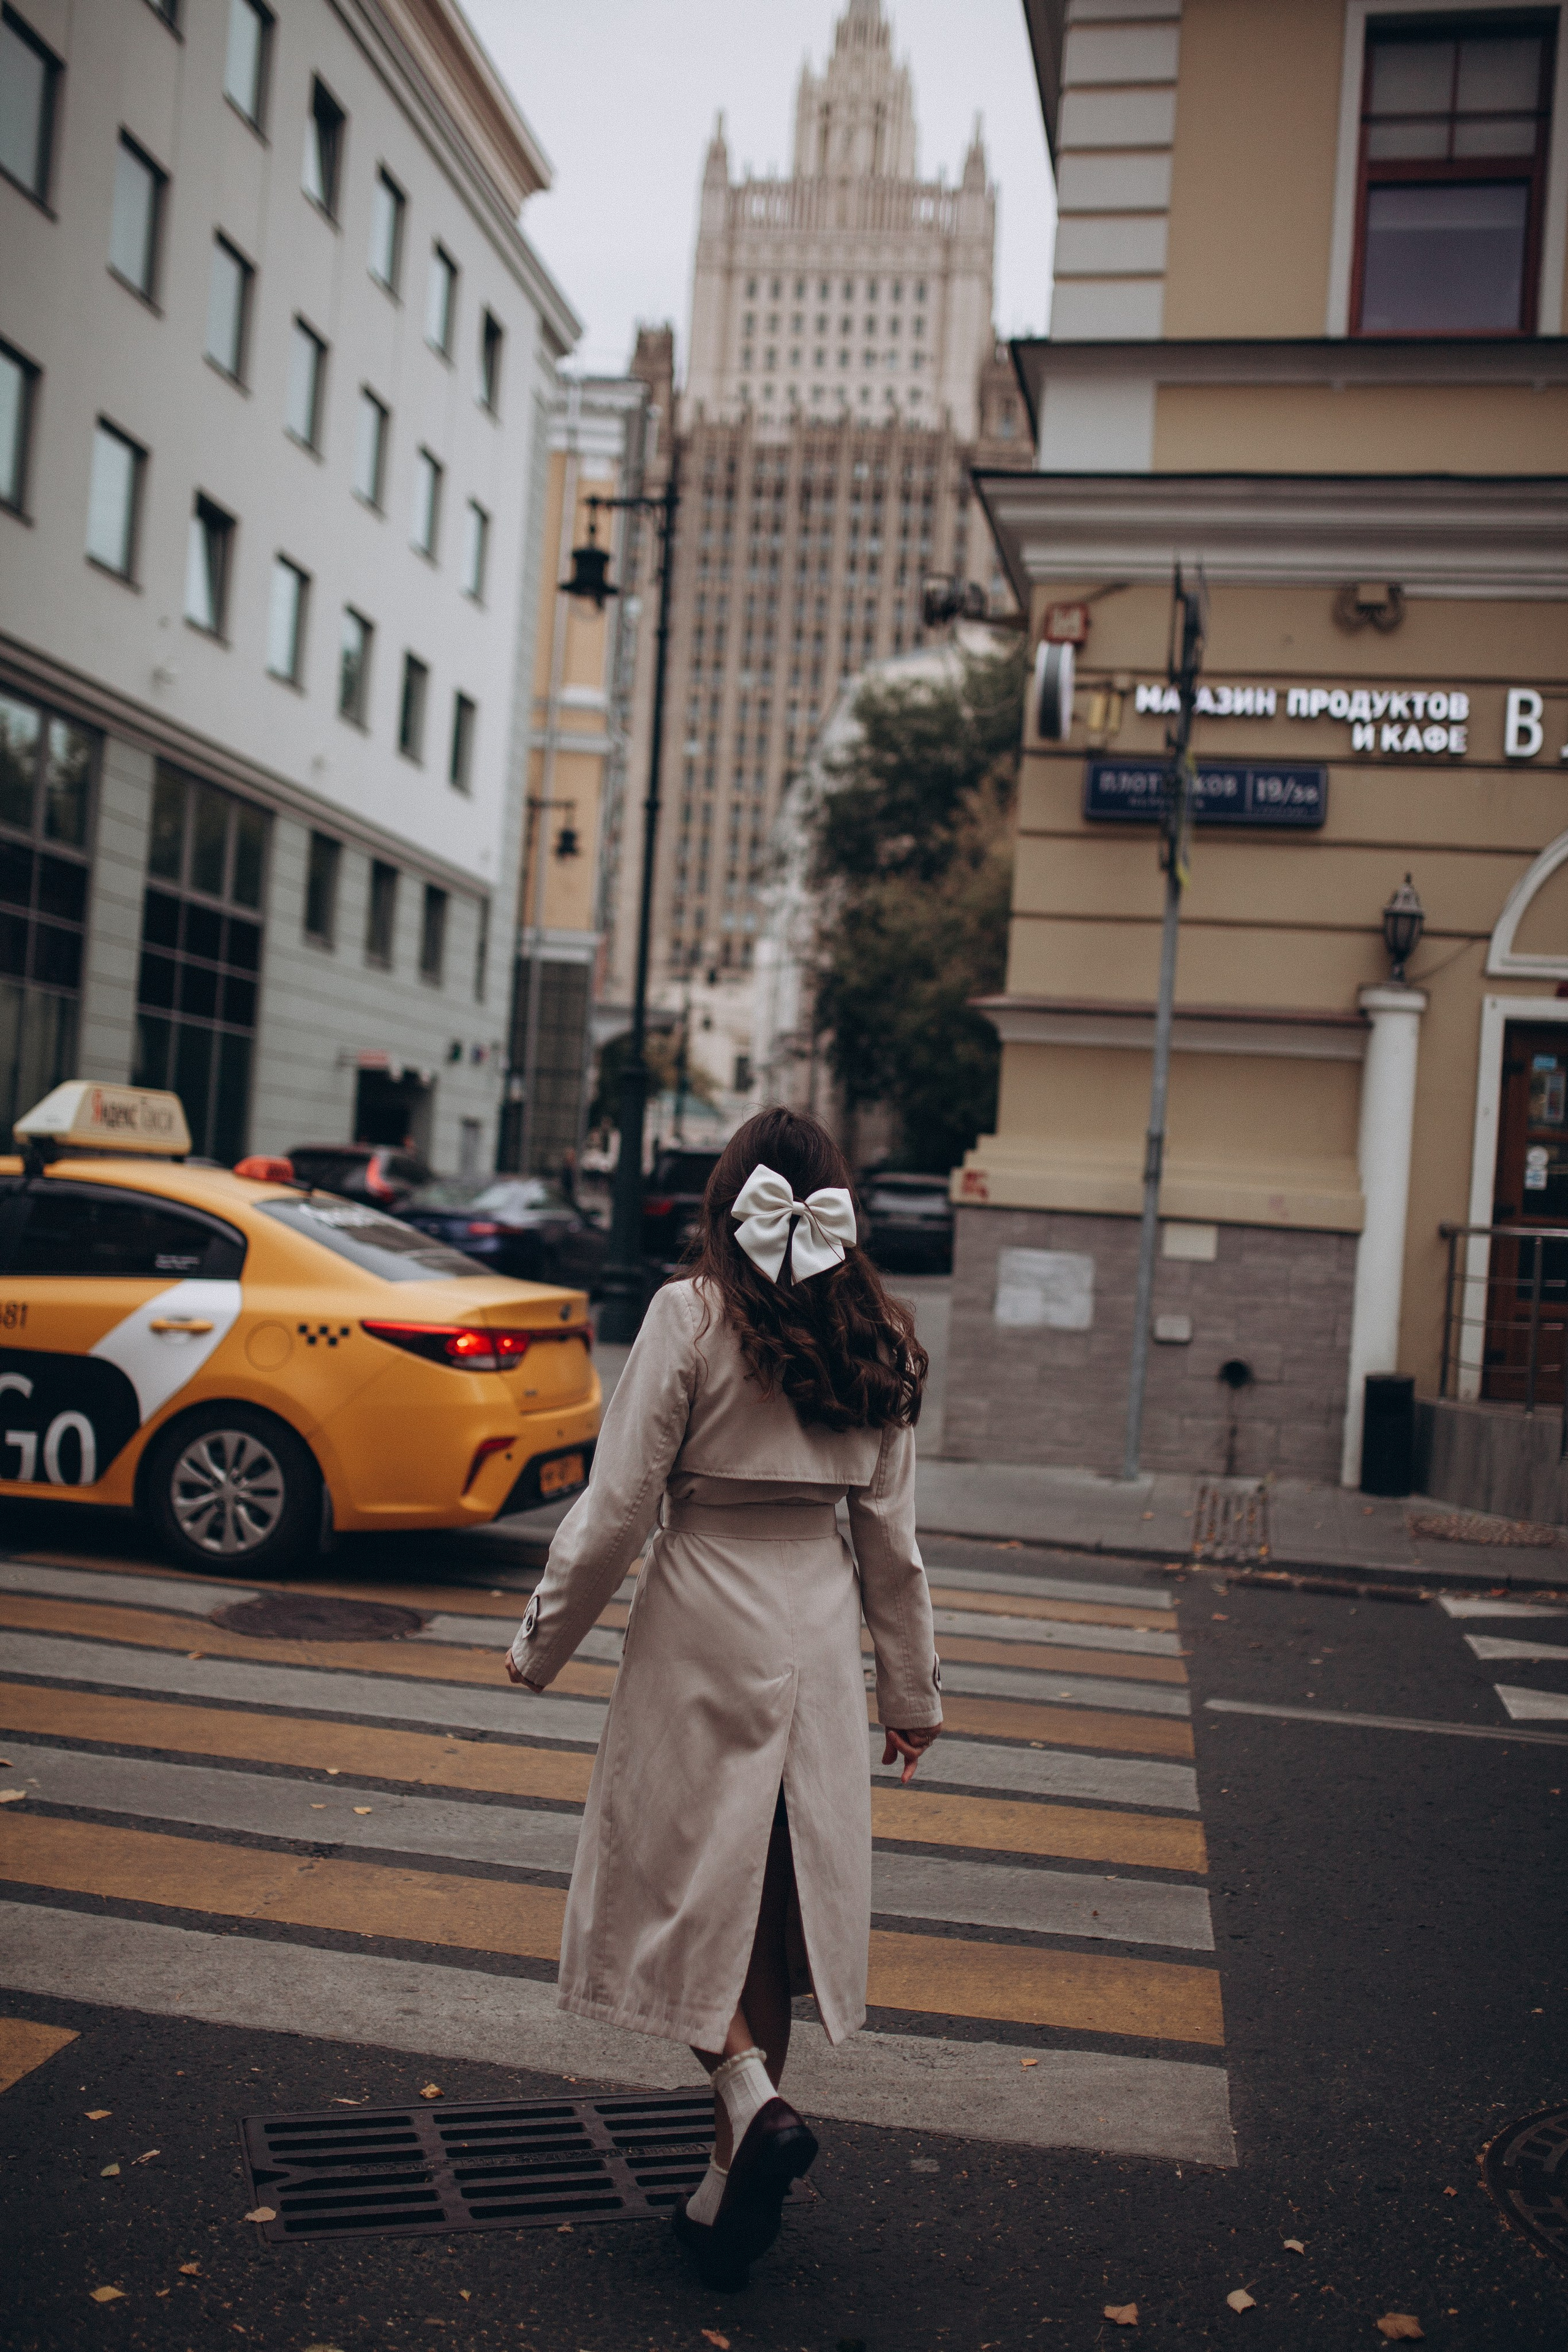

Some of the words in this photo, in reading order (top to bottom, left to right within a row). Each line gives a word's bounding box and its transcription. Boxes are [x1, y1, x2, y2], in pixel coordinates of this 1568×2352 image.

[1135, 684, 1277, 717] МААЗИН
[1287, 688, 1470, 723] ПРОДУКТОВ
[1352, 723, 1376, 752] И
[1380, 723, 1468, 755] КАФЕ
[1099, 771, 1238, 797] ПЛОТКОВ
